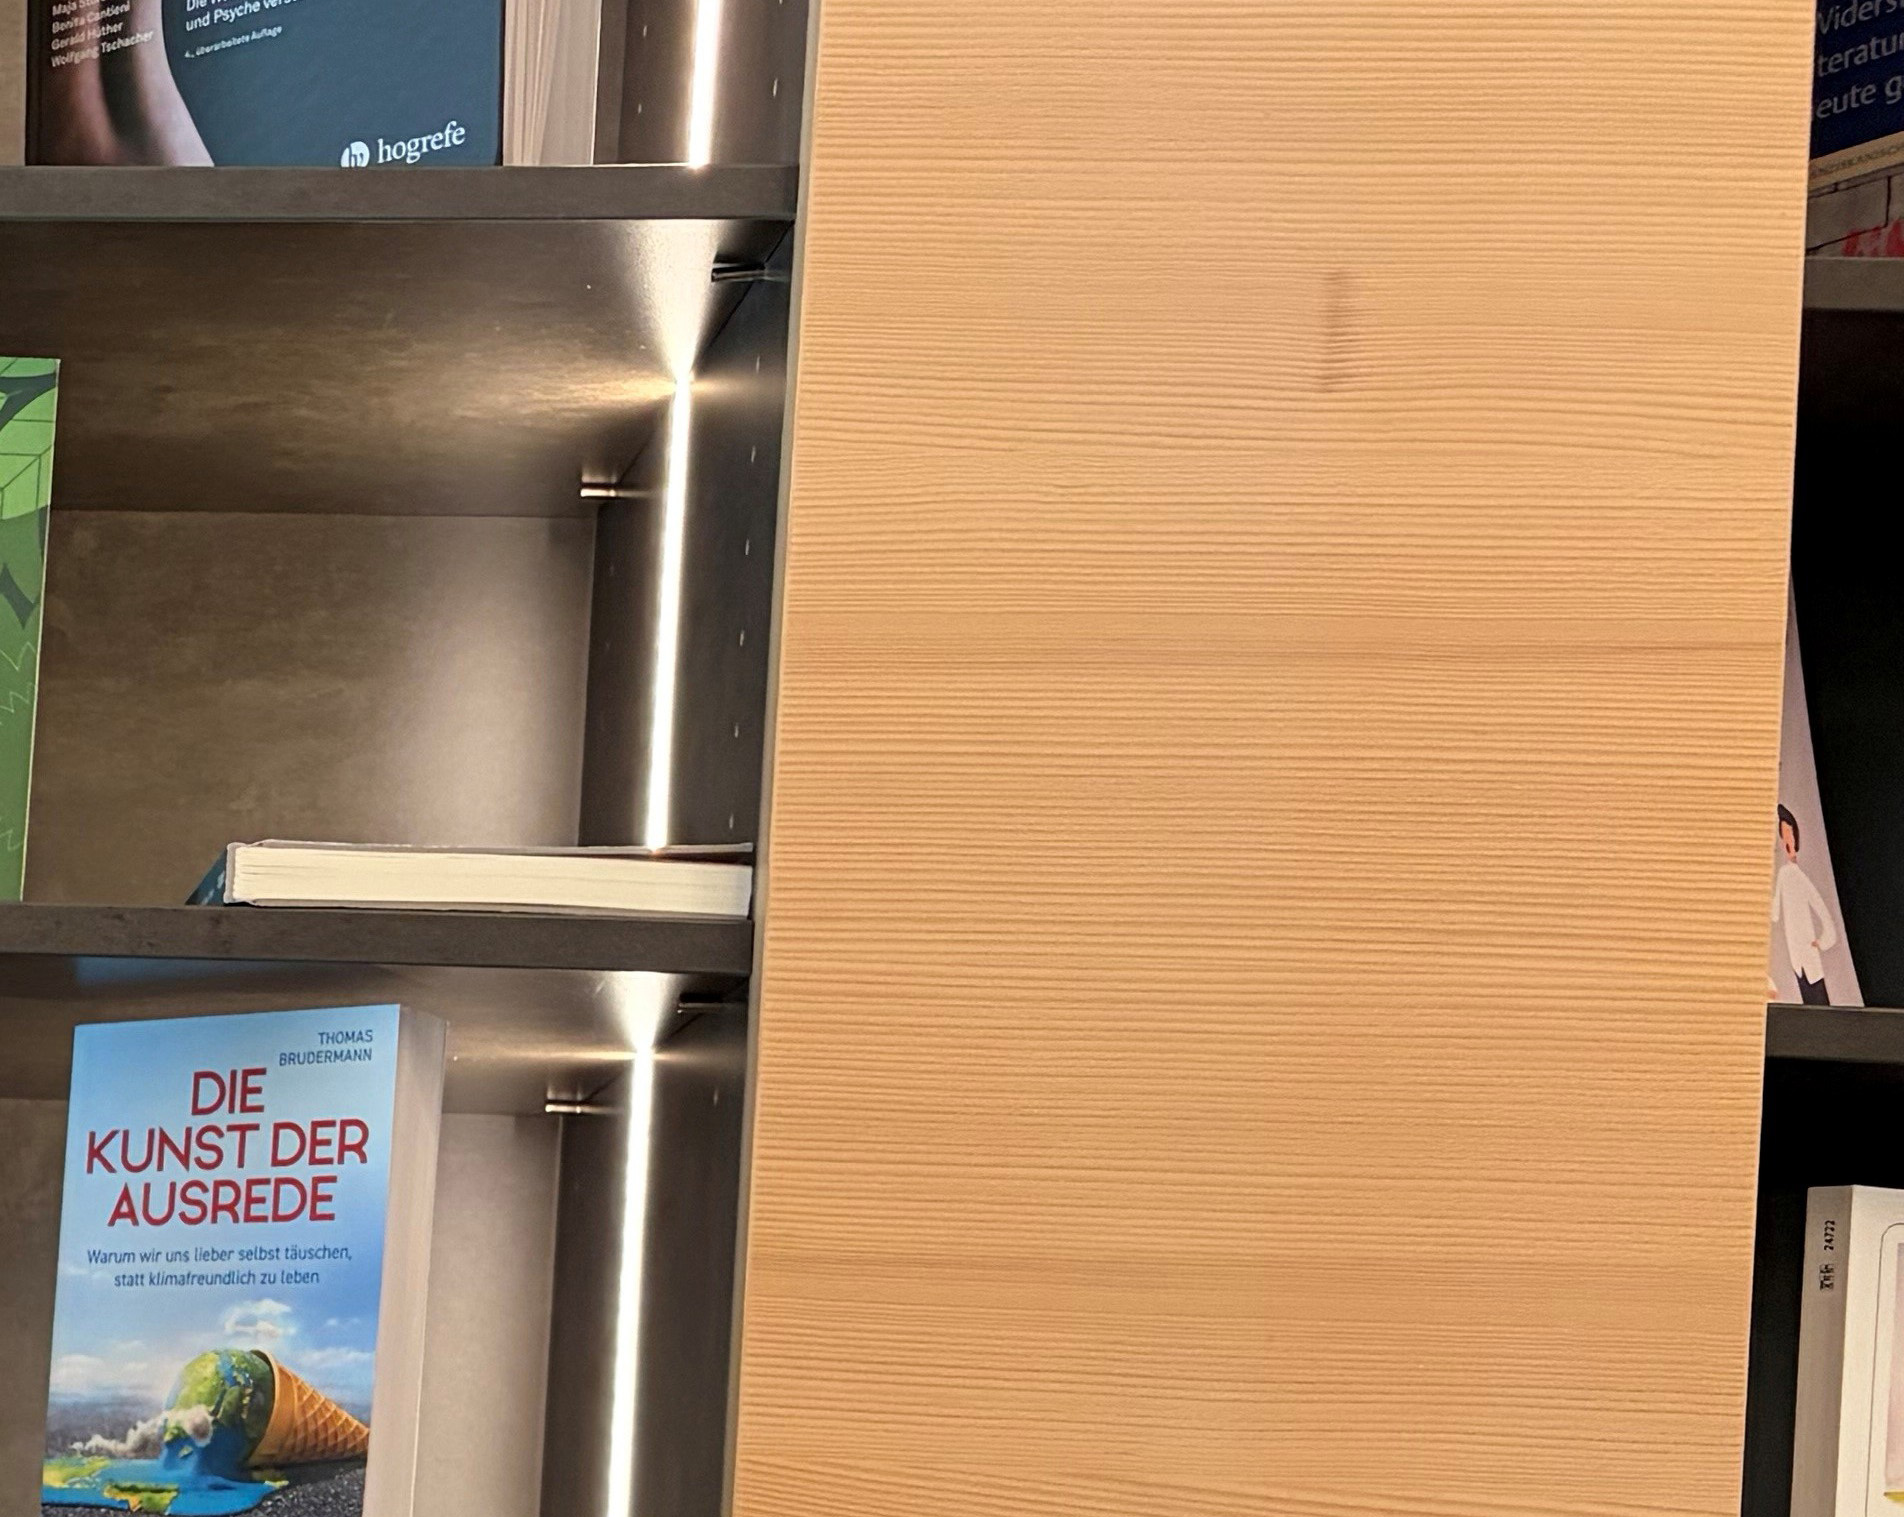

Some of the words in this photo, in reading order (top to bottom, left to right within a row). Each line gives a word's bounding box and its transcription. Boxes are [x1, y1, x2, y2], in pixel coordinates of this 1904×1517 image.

[185, 13, 210, 32] und
[213, 1, 261, 24] Psyche
[377, 119, 467, 165] hogrefe
[318, 1029, 373, 1046] THOMAS
[279, 1048, 373, 1067] BRUDERMANN
[192, 1067, 267, 1116] DIE
[86, 1123, 260, 1174] KUNST
[271, 1118, 369, 1168] DER
[107, 1175, 338, 1228] AUSREDE
[87, 1249, 136, 1265] Warum
[140, 1248, 162, 1263] wir
[165, 1250, 190, 1263] uns
[194, 1246, 235, 1262] lieber
[238, 1245, 280, 1261] selbst
[284, 1244, 353, 1264] täuschen,
[114, 1273, 145, 1287] statt
[148, 1270, 256, 1288] klimafreundlich
[280, 1270, 319, 1285] leben
